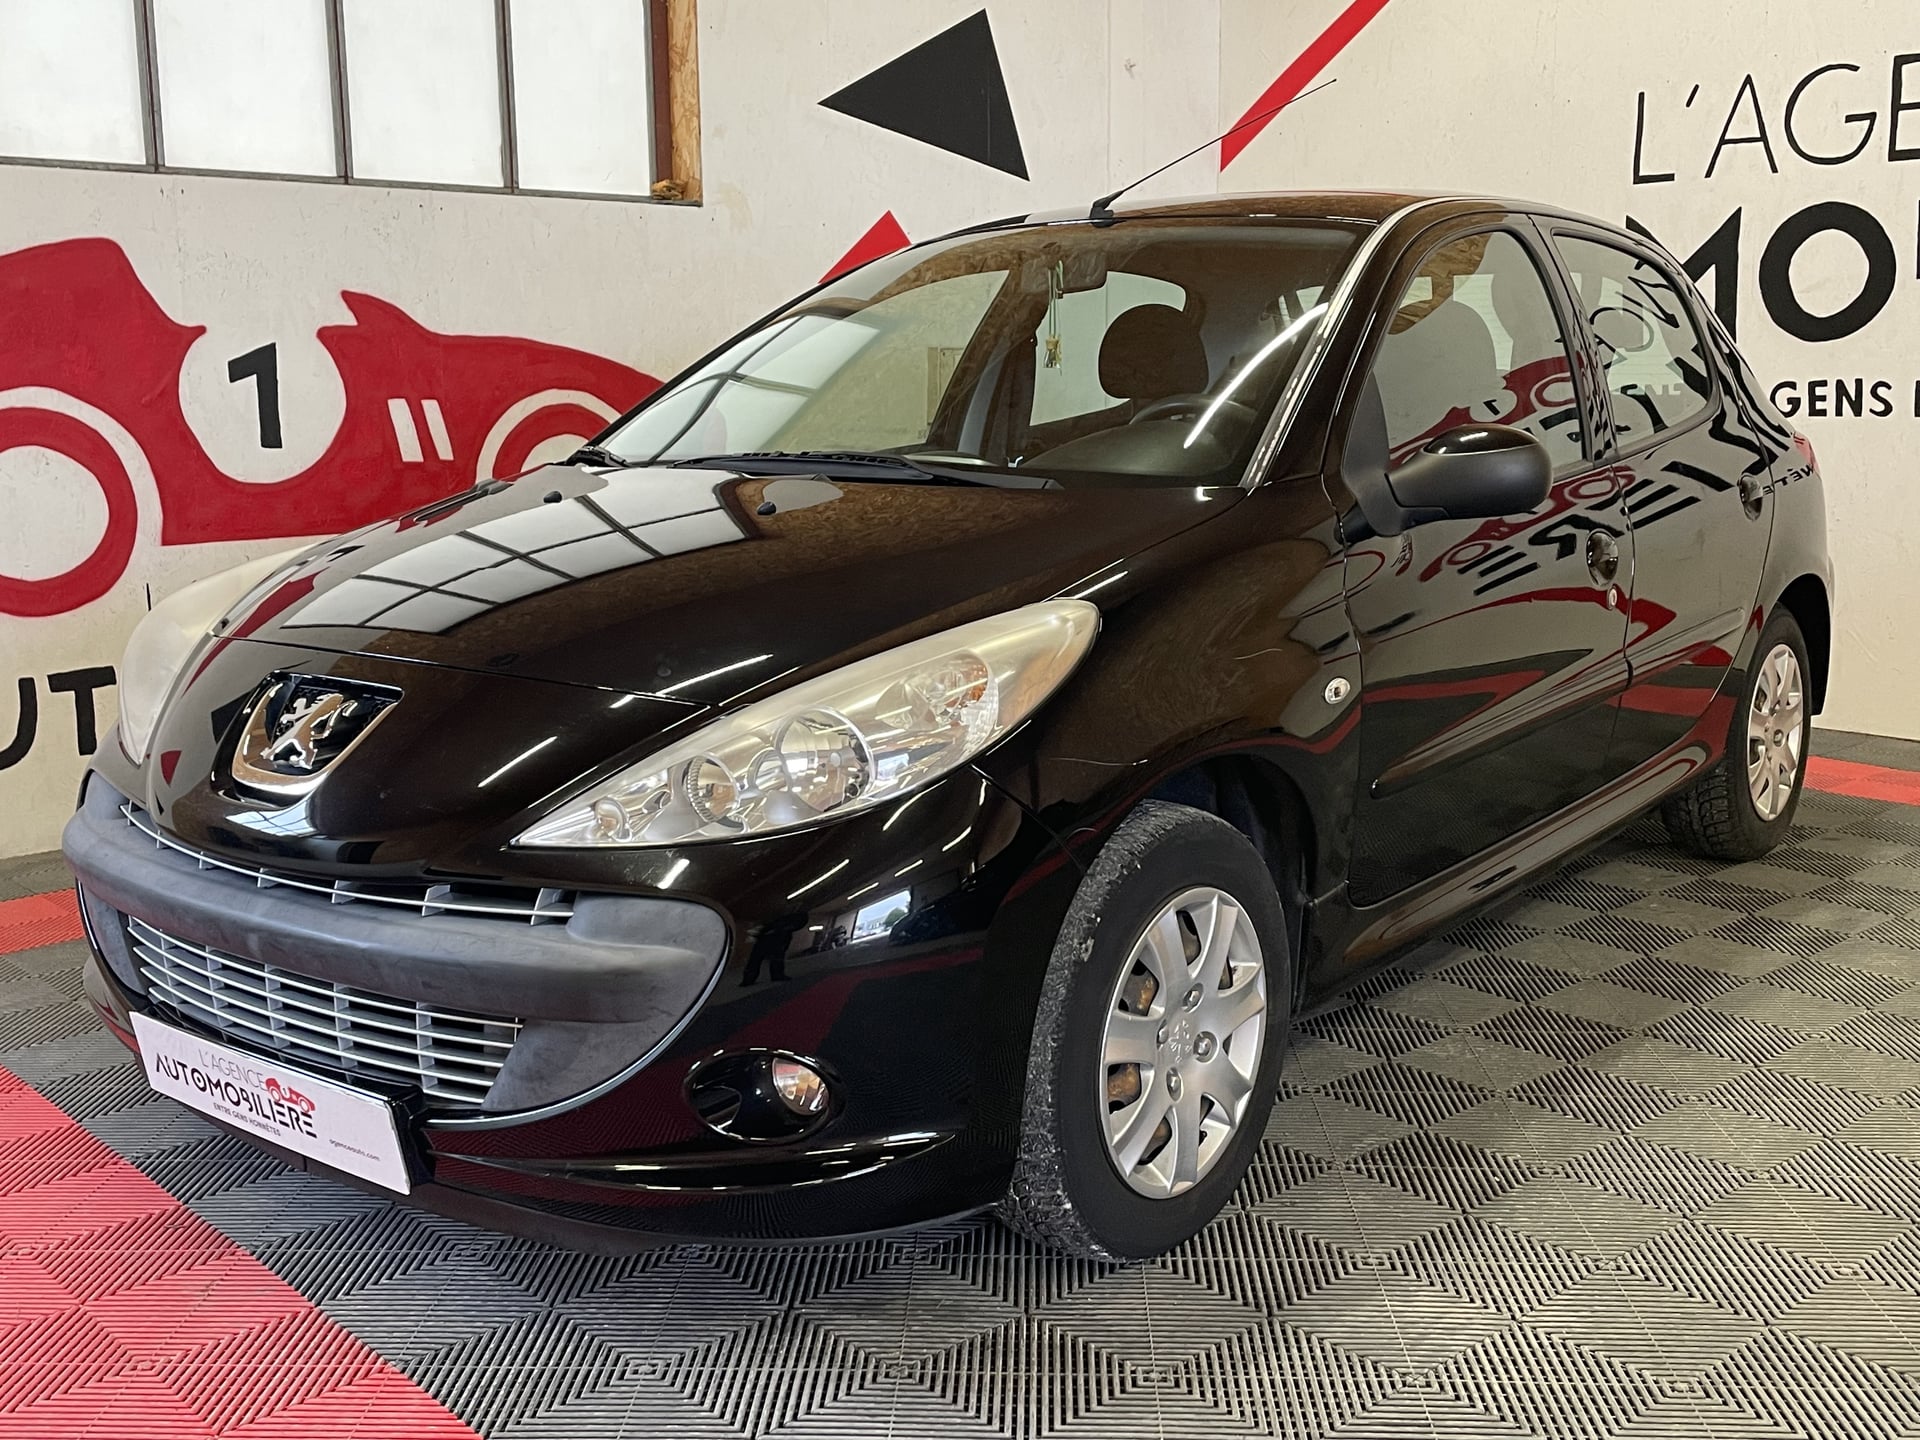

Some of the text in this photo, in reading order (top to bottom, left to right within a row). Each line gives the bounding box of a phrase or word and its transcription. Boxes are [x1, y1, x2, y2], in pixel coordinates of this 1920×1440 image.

[227, 341, 283, 450] 1
[1769, 377, 1894, 419] GENS
[198, 1048, 269, 1092] L'AGENCE
